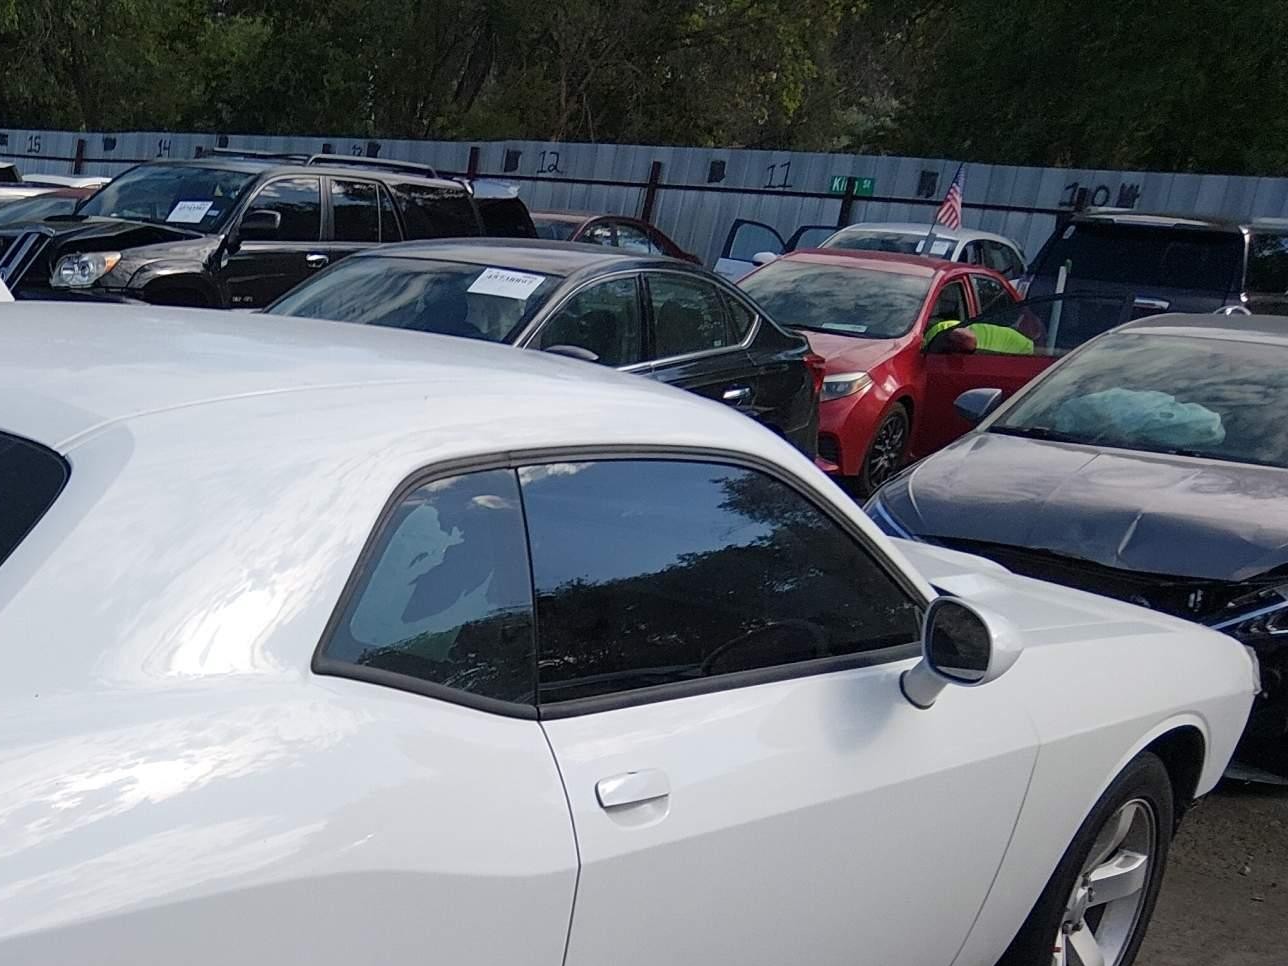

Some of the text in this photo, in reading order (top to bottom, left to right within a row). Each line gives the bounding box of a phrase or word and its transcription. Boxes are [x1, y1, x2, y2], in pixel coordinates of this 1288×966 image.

[156, 138, 172, 158] 14
[536, 150, 561, 173] 12
[764, 161, 792, 188] 11
